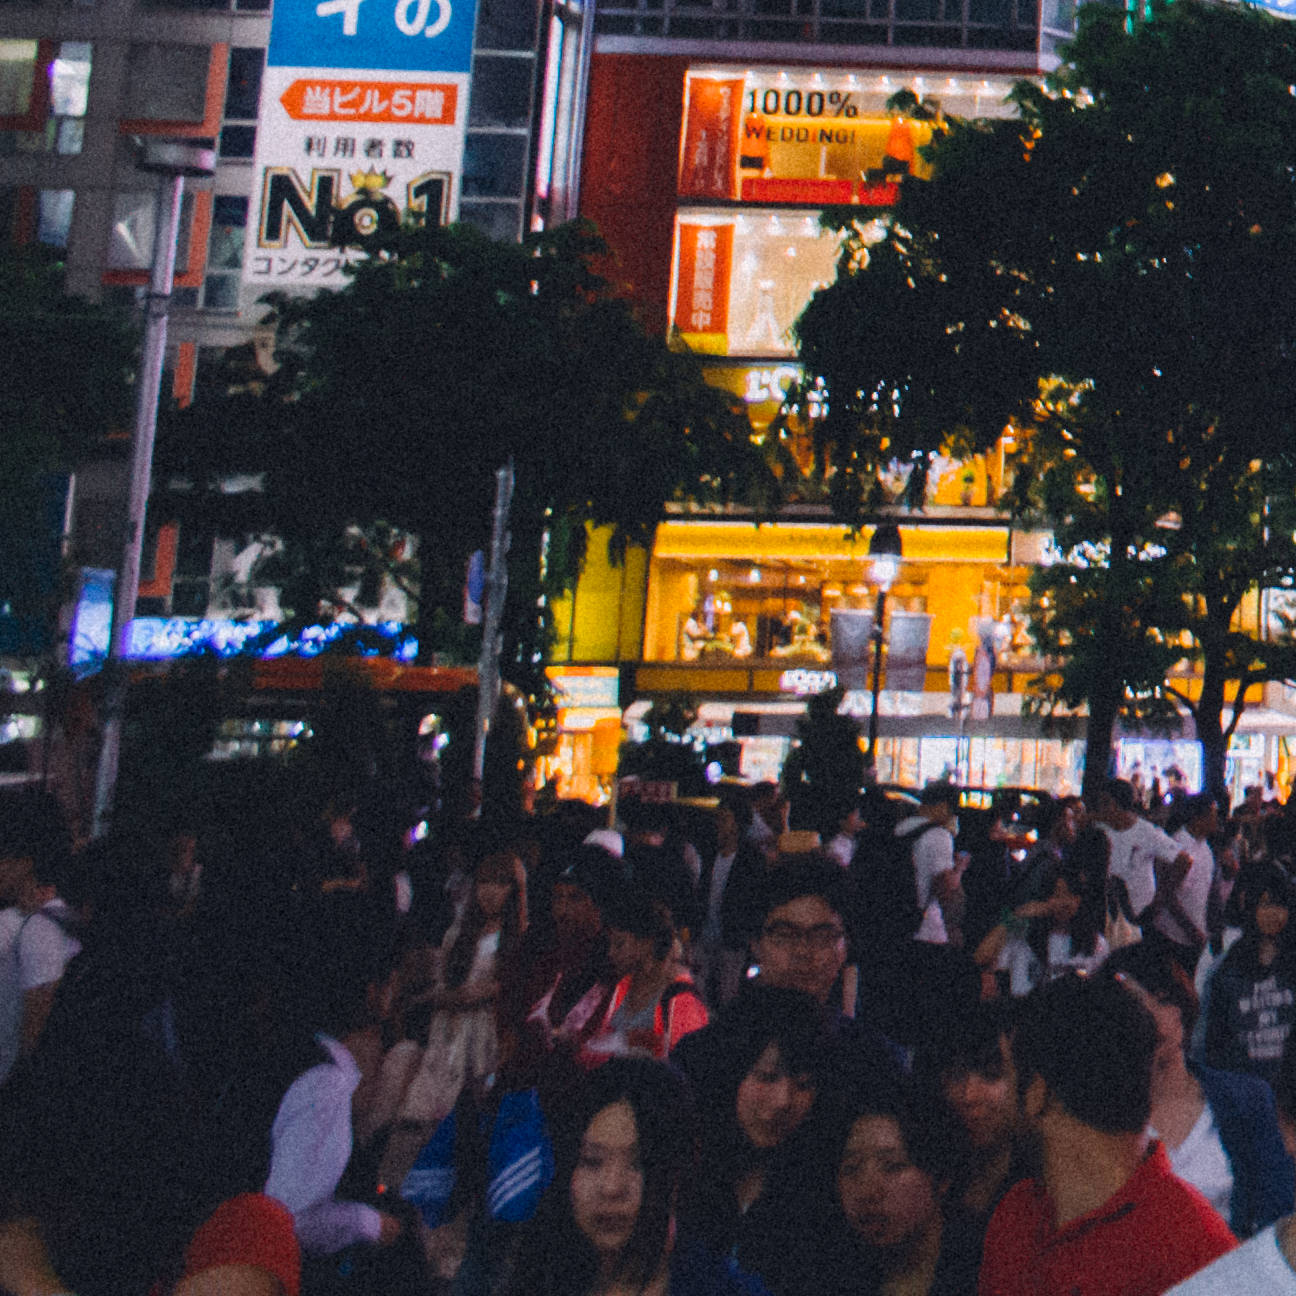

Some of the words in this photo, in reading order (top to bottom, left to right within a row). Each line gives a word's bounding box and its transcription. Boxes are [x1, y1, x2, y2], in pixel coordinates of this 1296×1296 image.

[302, 86, 445, 118] 当ビル5階
[750, 88, 858, 118] 1000%
[304, 135, 416, 160] 利用者数
